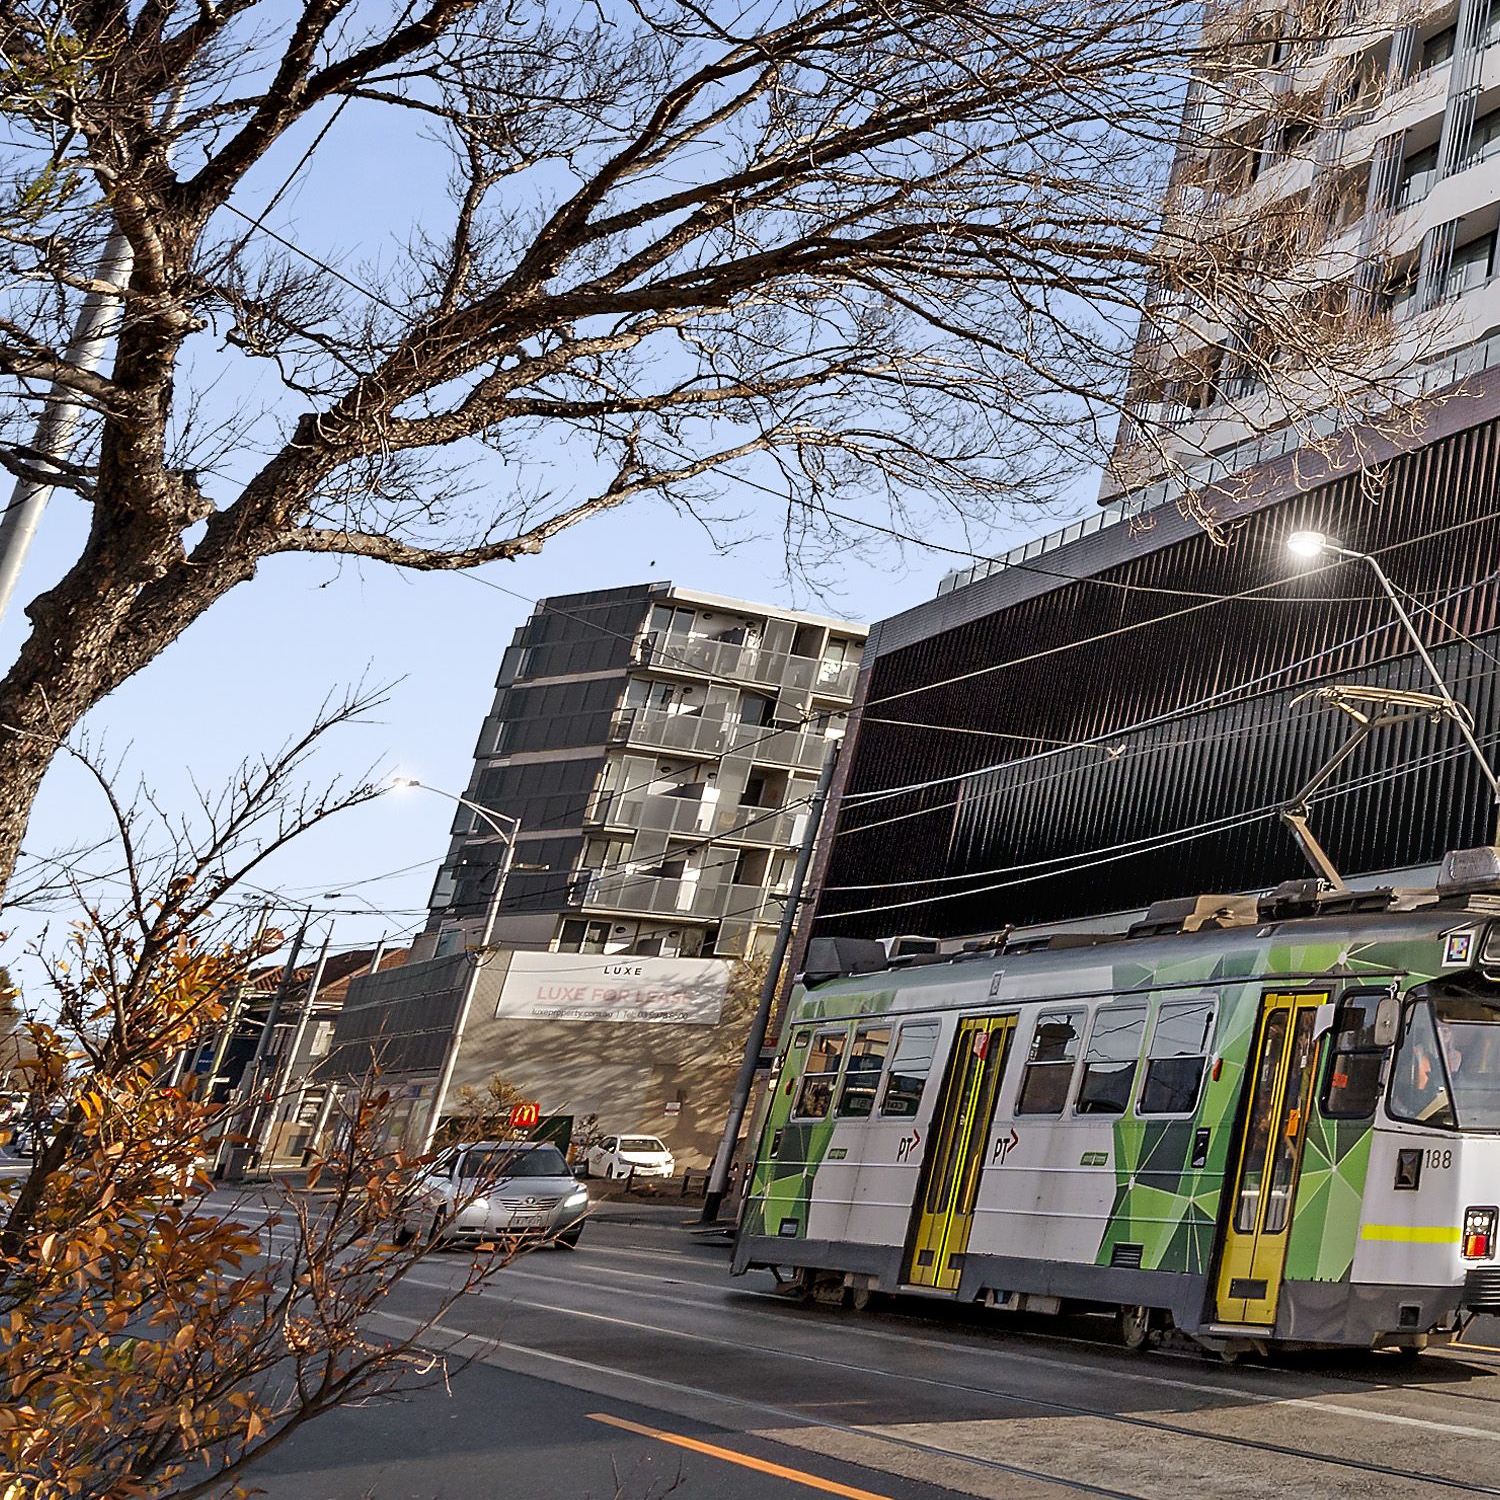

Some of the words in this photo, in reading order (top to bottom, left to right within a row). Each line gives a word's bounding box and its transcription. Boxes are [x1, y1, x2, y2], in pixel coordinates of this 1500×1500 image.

[604, 966, 642, 977] LUXE
[537, 986, 587, 1001] LUXE
[591, 988, 630, 1002] FOR
[635, 990, 692, 1005] LEASE
[1425, 1149, 1452, 1169] 188
